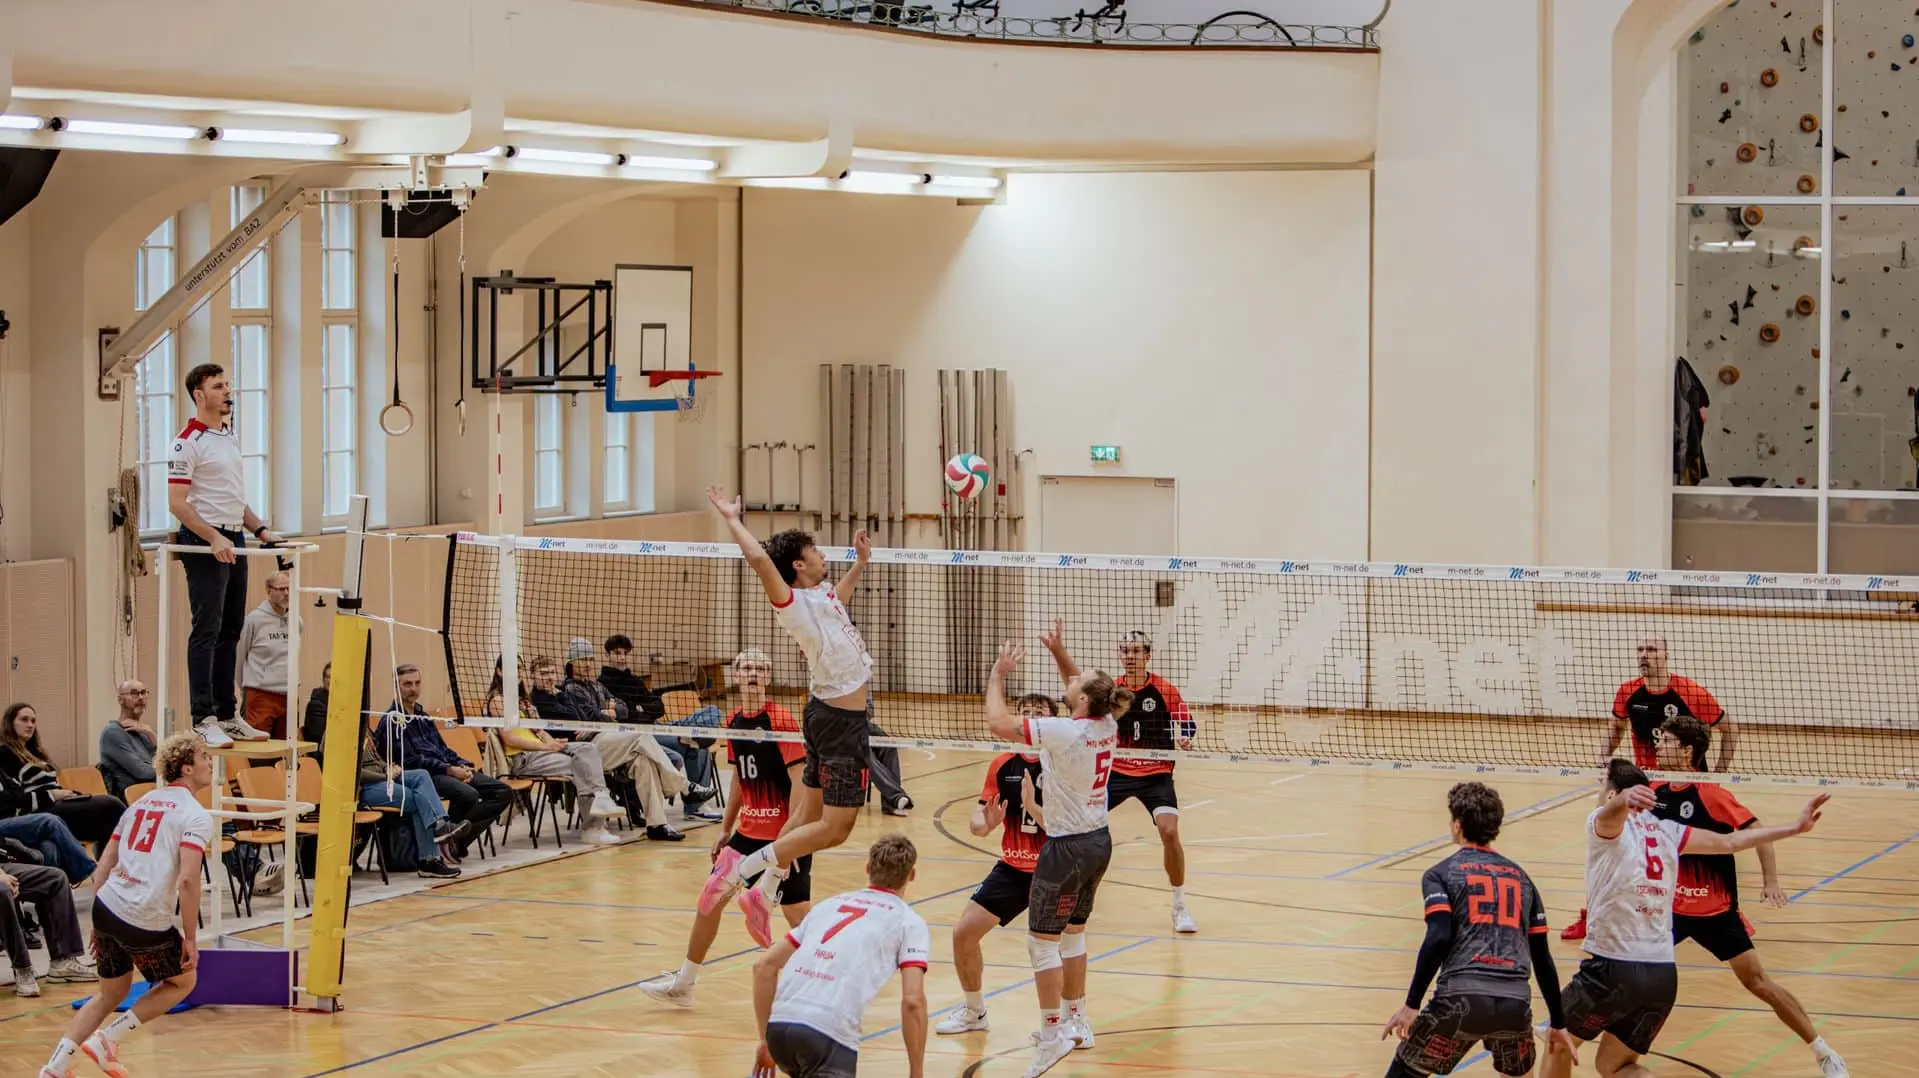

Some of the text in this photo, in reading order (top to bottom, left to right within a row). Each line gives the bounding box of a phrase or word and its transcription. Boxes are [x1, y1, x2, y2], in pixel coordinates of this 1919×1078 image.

[226, 236, 244, 253] vom
[243, 217, 261, 237] BA2
[538, 538, 566, 549] M-net
[586, 541, 619, 550] m-net.de
[639, 541, 667, 553] M-net
[894, 551, 928, 561] m-net.de
[951, 551, 979, 563] M-net
[1001, 554, 1036, 564] m-net.de
[1058, 554, 1087, 567] M-net
[1110, 557, 1144, 567] m-net.de
[1168, 557, 1197, 570] M-net
[1220, 560, 1256, 570] m-net.de
[1280, 560, 1309, 573] M-net
[1333, 563, 1369, 573] m-net.de
[1393, 563, 1424, 576] M-net
[1447, 566, 1485, 576] m-net.de
[1509, 566, 1540, 579] M-net
[1564, 569, 1602, 580] m-net.de
[1626, 569, 1658, 582] M-net
[1682, 573, 1720, 584] m-net.de
[1746, 573, 1778, 586] M-net
[1802, 576, 1841, 587] m-net.de
[1867, 576, 1900, 589] M-net
[738, 754, 758, 780] 16
[1092, 750, 1111, 790] 5
[127, 808, 165, 853] 13
[1645, 836, 1664, 881] 6
[1465, 874, 1522, 929] 20
[820, 904, 869, 945] 7
